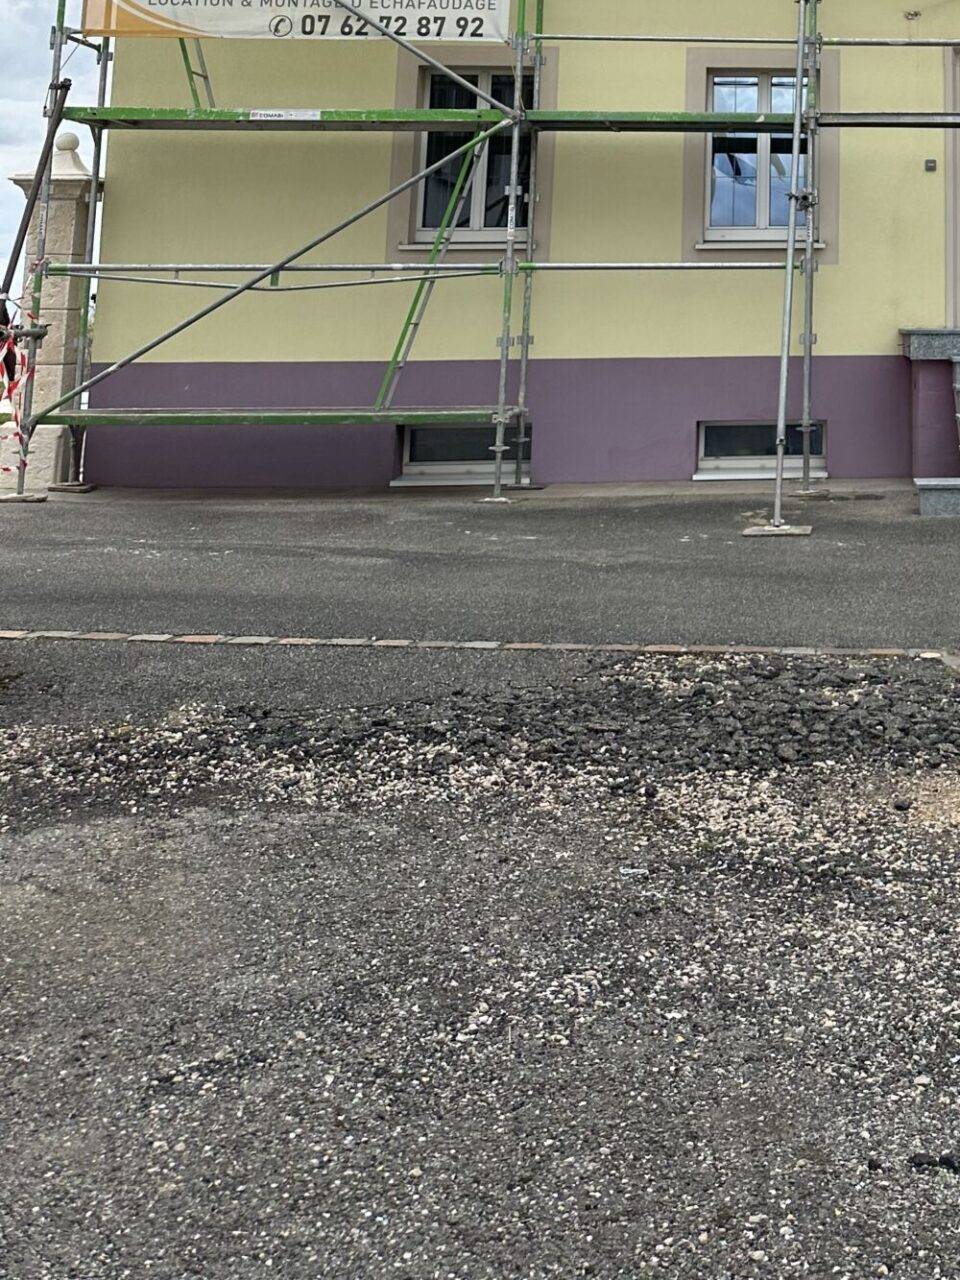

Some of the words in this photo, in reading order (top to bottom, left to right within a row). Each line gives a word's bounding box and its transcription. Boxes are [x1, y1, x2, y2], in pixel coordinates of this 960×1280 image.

[301, 15, 331, 36] 07
[340, 16, 369, 37] 62
[379, 16, 407, 37] 72
[416, 16, 446, 37] 87
[456, 16, 484, 38] 92
